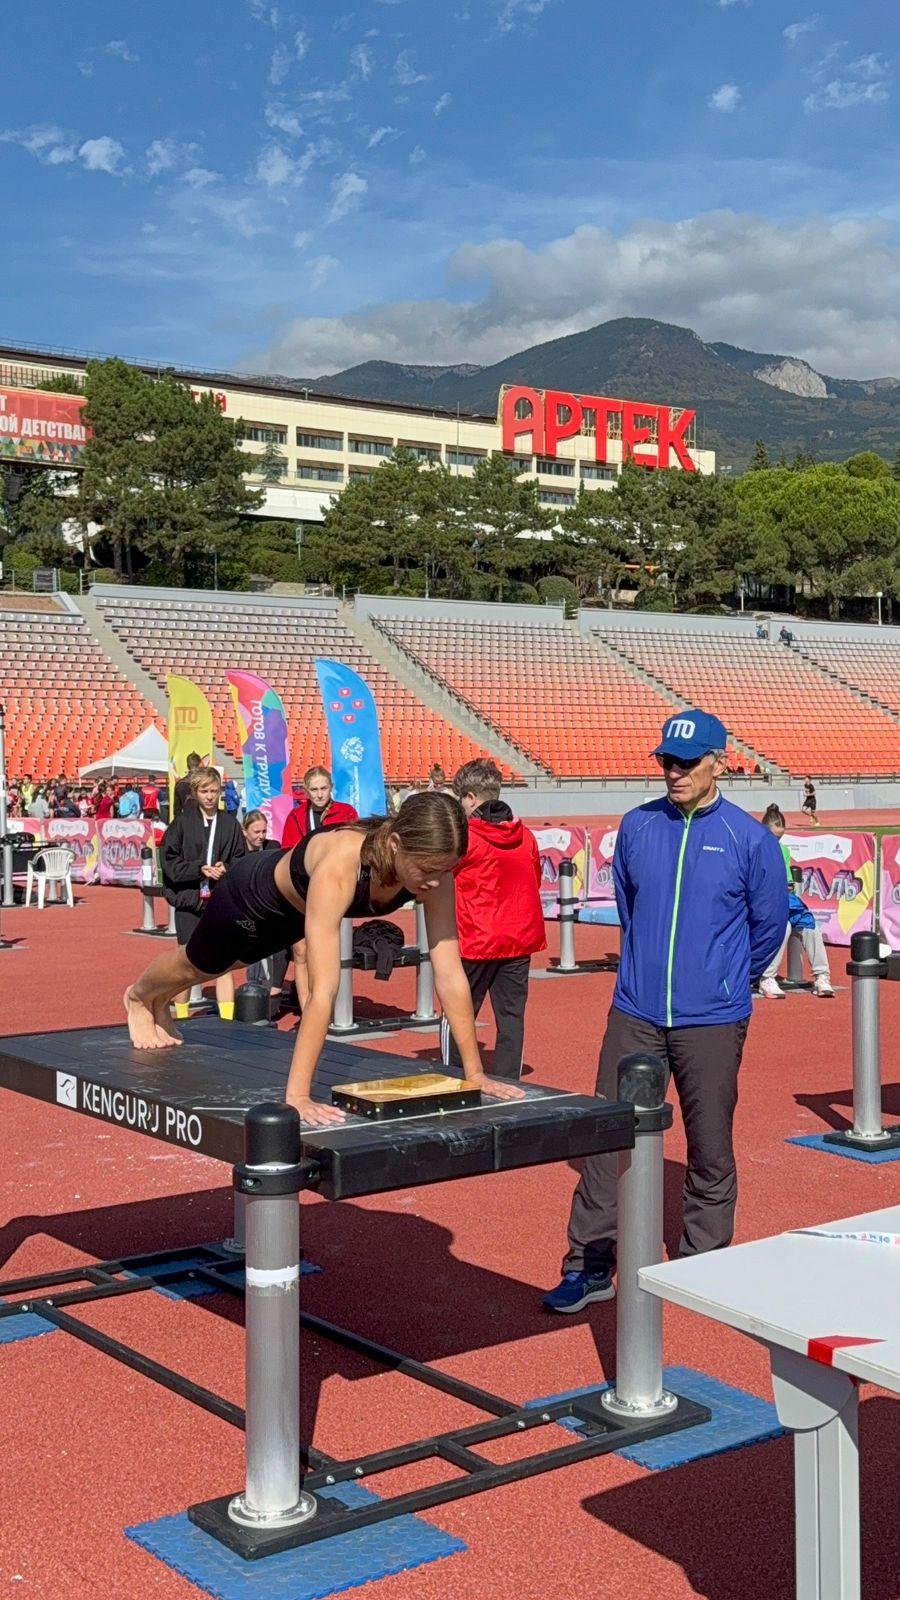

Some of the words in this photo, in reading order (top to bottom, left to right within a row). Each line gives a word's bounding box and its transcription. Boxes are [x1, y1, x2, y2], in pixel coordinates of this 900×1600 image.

[21, 418, 86, 441] ДЕТСТВА!
[502, 386, 696, 471] АРТЕК
[251, 700, 266, 740] ГОТОВ
[256, 755, 272, 796] ТРУДУ
[166, 1106, 202, 1146] PRO
